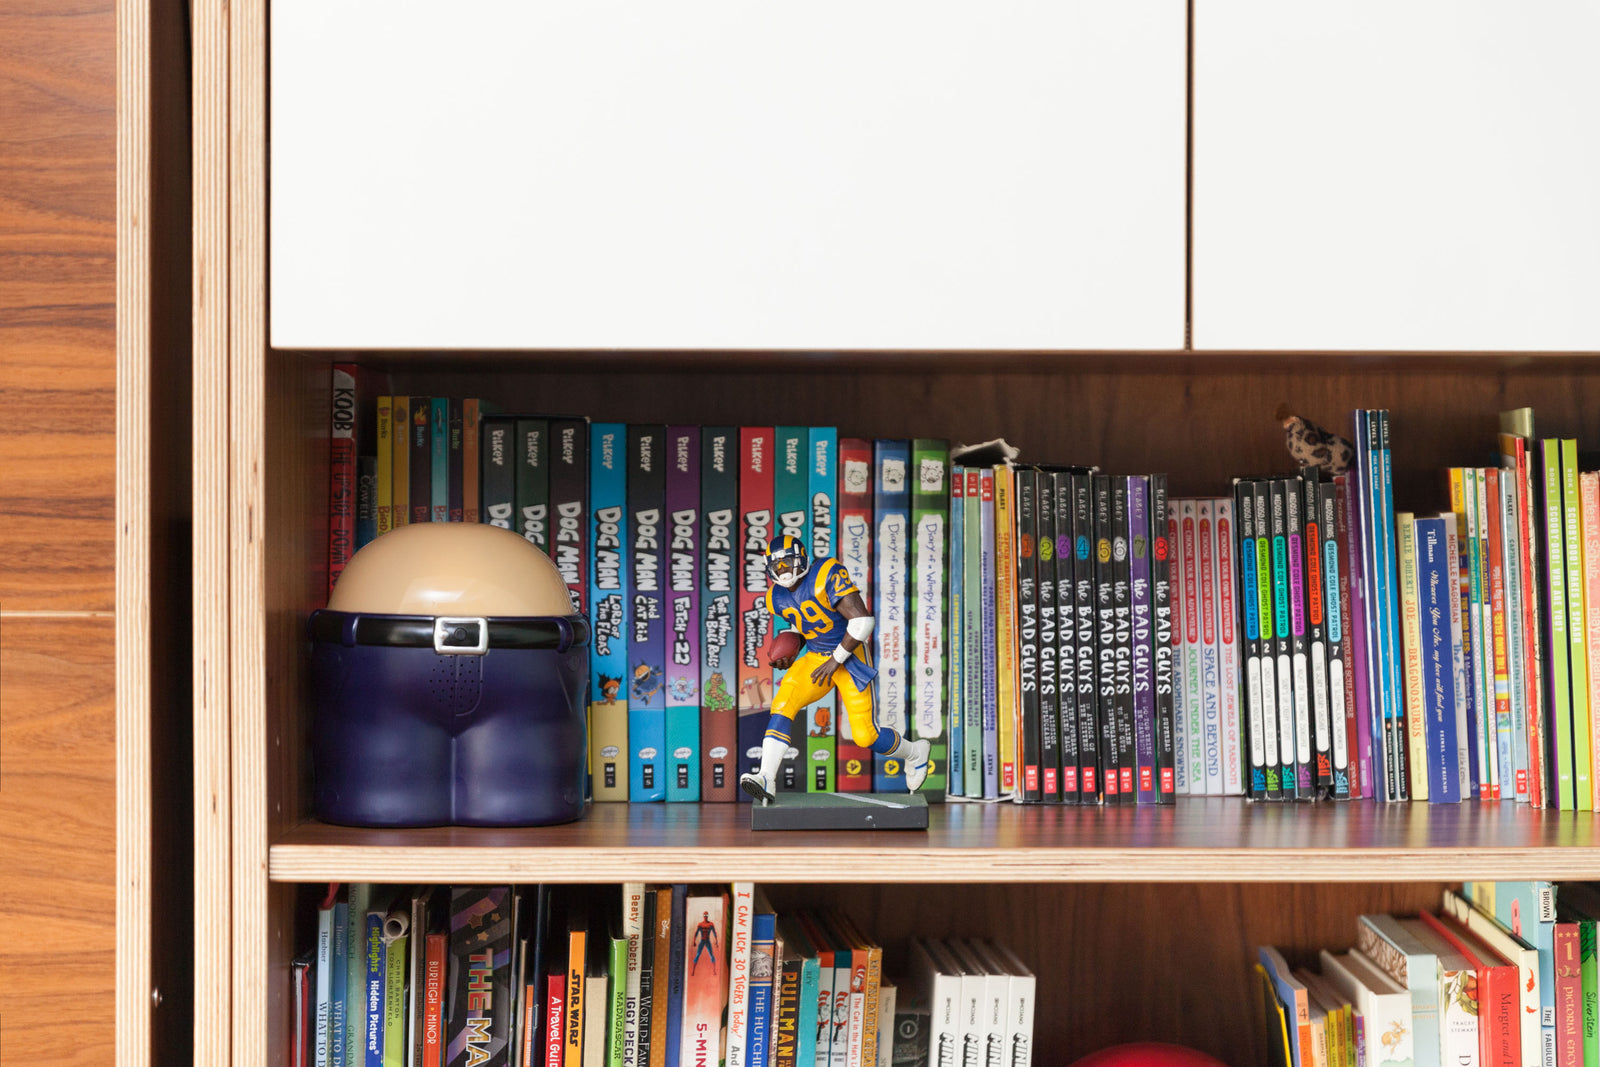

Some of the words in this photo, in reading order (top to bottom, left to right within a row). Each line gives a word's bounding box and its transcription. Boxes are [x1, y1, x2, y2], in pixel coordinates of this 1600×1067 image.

[333, 388, 353, 431] KOOB
[333, 446, 352, 466] THE
[813, 492, 831, 525] CAT
[1584, 478, 1597, 521] Charles
[331, 472, 352, 565] UPSIDE-DOWN
[522, 504, 547, 545] DOG
[557, 501, 582, 543] DOG
[595, 506, 622, 549] DOG
[635, 509, 660, 550] DOG
[671, 509, 696, 550] DOG
[708, 509, 733, 550] DOG
[745, 510, 771, 551] DOG
[1586, 524, 1597, 539] M.
[843, 524, 864, 563] Diary
[886, 523, 902, 551] Diary
[924, 523, 938, 551] Diary
[1402, 524, 1412, 554] BERLIE
[1427, 528, 1437, 563] Tillman
[1550, 505, 1560, 565] SCOOBY-DOO!
[1567, 507, 1578, 566] SCOOBY-DOO!
[557, 544, 580, 585] MAN
[597, 551, 621, 589] MAN
[890, 554, 901, 562] of
[926, 554, 936, 562] of
[1327, 543, 1336, 574] DESMOND
[1448, 534, 1459, 577] MICHELLE
[1587, 540, 1600, 579] Schulz
[635, 552, 659, 592] MAN
[672, 552, 695, 592] MAN
[708, 553, 731, 592] MAN
[745, 553, 770, 593] MAN
[830, 570, 851, 593] 29
[850, 567, 863, 579] of
[886, 571, 902, 603] Wimpy
[923, 571, 939, 603] Wimpy
[1329, 575, 1337, 591] COLE
[1404, 559, 1414, 596] DOHERTY
[1430, 569, 1440, 605] Wherever
[1551, 568, 1561, 587] WHO
[1569, 569, 1579, 599] MAKES
[1022, 578, 1035, 599] the
[1041, 580, 1054, 602] the
[1058, 579, 1072, 600] the
[1078, 580, 1091, 601] the
[1099, 582, 1112, 604] the
[1115, 580, 1127, 602] the
[1134, 579, 1147, 599] the
[1156, 580, 1170, 602] the
[1330, 592, 1338, 613] GHOST
[1450, 578, 1460, 624] MAGORIAN
[1552, 589, 1562, 606] ARE
[609, 595, 622, 626] LORD
[634, 595, 647, 620] CAT
[782, 599, 834, 640] 29
[888, 605, 902, 621] Kid
[924, 605, 939, 621] Kid
[1022, 604, 1036, 640] BAD
[1059, 605, 1074, 641] BAD
[1134, 604, 1149, 640] BAD
[1406, 599, 1416, 621] JOE
[1429, 606, 1442, 625] You
[1554, 608, 1564, 632] YOU?
[1041, 607, 1056, 643] BAD
[1078, 606, 1092, 642] BAD
[1100, 608, 1114, 644] BAD
[1115, 607, 1129, 643] BAD
[1157, 607, 1171, 643] BAD
[1331, 614, 1340, 640] PATROL
[1571, 611, 1583, 643] SPLASH
[1172, 648, 1181, 668] THE
[1225, 646, 1233, 668] THE
[1342, 635, 1352, 668] STOLEN
[1432, 649, 1441, 660] my
[1452, 638, 1465, 662] The
[1022, 644, 1036, 692] GUYS
[1041, 646, 1056, 695] GUYS
[1060, 645, 1075, 694] GUYS
[1079, 646, 1093, 694] GUYS
[1100, 648, 1115, 696] GUYS
[1115, 647, 1130, 695] GUYS
[1135, 644, 1150, 692] GUYS
[1157, 647, 1172, 695] GUYS
[1188, 645, 1199, 695] JOURNEY
[1204, 647, 1216, 688] SPACE
[1226, 667, 1235, 690] LOST
[1434, 661, 1443, 677] love
[1344, 669, 1355, 719] SCULPTURE
[1408, 647, 1422, 738] DRAGONOSAURUS
[1435, 678, 1444, 691] will
[1435, 691, 1446, 708] find
[887, 681, 898, 729] KINNEY
[923, 681, 935, 730] KINNEY
[1173, 670, 1184, 734] ABOMINABLE
[1190, 698, 1201, 735] UNDER
[1205, 691, 1217, 720] AND
[1226, 692, 1237, 727] JEWELS
[1435, 709, 1445, 722] you
[1191, 737, 1202, 758] THE
[1206, 724, 1219, 777] BEYOND
[1228, 729, 1237, 742] OF
[1175, 736, 1185, 788] SNOWMAN
[1192, 761, 1202, 783] SEA
[628, 894, 640, 922] Beaty
[738, 891, 751, 899] I
[1542, 890, 1551, 919] BROWN
[737, 905, 749, 927] CAN
[368, 927, 381, 972] Highlights
[628, 934, 640, 972] Roberts
[736, 932, 748, 953] LICK
[1564, 942, 1574, 960] 1
[467, 947, 494, 1011] THE
[734, 958, 746, 971] 30
[869, 959, 879, 978] MY
[368, 980, 381, 1012] Hidden
[428, 961, 438, 1004] BURLEIGH
[571, 969, 581, 1007] STAR
[732, 974, 746, 1005] TIGERS
[387, 972, 395, 1027] LICHTENHELD
[552, 996, 562, 1004] A
[625, 997, 636, 1025] IGGY
[755, 989, 765, 1013] THE
[777, 971, 798, 1057] PULLMAN
[853, 996, 862, 1009] The
[866, 981, 879, 1036] FRIENDLY
[1498, 993, 1513, 1036] Margret
[1585, 991, 1596, 1038] Silverstein
[318, 1002, 328, 1037] WHAT
[333, 1000, 343, 1035] WHAT
[427, 1014, 437, 1044] MINOR
[551, 1005, 562, 1040] Travel
[569, 1009, 580, 1047] WARS
[613, 992, 624, 1059] MADAGASCAR
[730, 1009, 745, 1039] Today!
[853, 1011, 861, 1022] Cat
[1544, 1009, 1552, 1023] THE
[318, 1041, 328, 1056] TO
[333, 1038, 343, 1052] TO
[851, 1044, 859, 1060] Hat's
[852, 1031, 860, 1043] the
[1501, 1039, 1512, 1058] and
[730, 1045, 741, 1066] And
